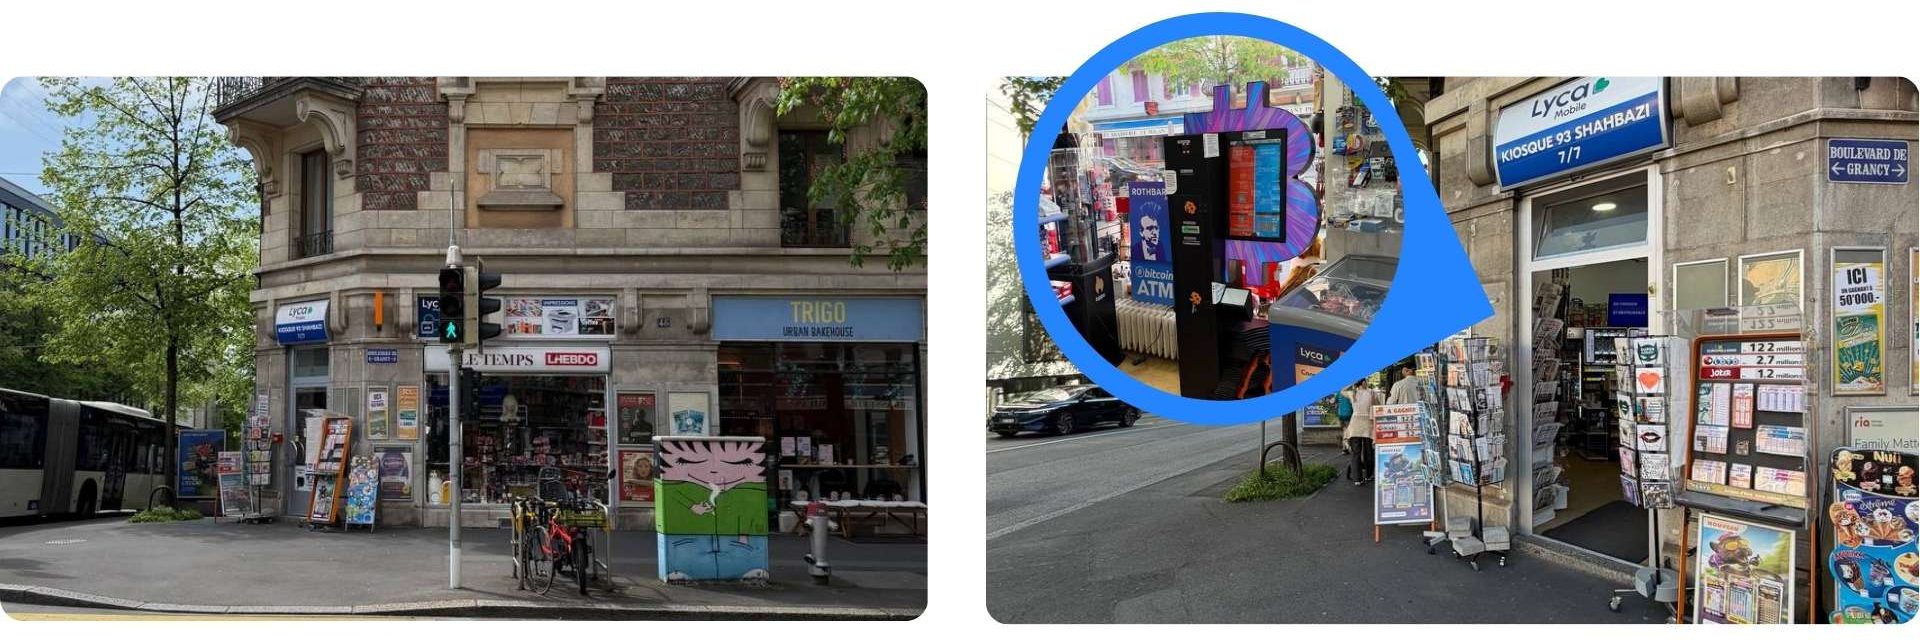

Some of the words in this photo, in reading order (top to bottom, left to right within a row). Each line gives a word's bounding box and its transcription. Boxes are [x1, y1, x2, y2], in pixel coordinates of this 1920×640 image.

[1531, 82, 1590, 118] Lyca
[1554, 102, 1587, 120] Mobile
[1501, 137, 1554, 163] KIOSQUE
[1556, 131, 1572, 146] 93
[1574, 104, 1651, 140] SHAHBAZI
[1558, 147, 1581, 164] 7/7
[1829, 146, 1891, 160] BOULEVARD
[1893, 149, 1907, 161] DE
[1847, 163, 1890, 176] GRANCY
[1131, 188, 1166, 196] ROTHBAR
[1144, 267, 1174, 280] bitcoin
[1847, 267, 1868, 284] ICI
[1137, 279, 1174, 299] ATM
[422, 299, 439, 310] Lyc
[288, 306, 308, 317] Lyca
[790, 301, 846, 323] TRIGO
[783, 326, 809, 337] URBAN
[811, 326, 854, 338] BAKEHOUSE
[482, 354, 534, 366] TEMPS
[1300, 347, 1324, 360] Lyca
[1855, 438, 1890, 451] Family
[1893, 438, 1919, 449] Matt
